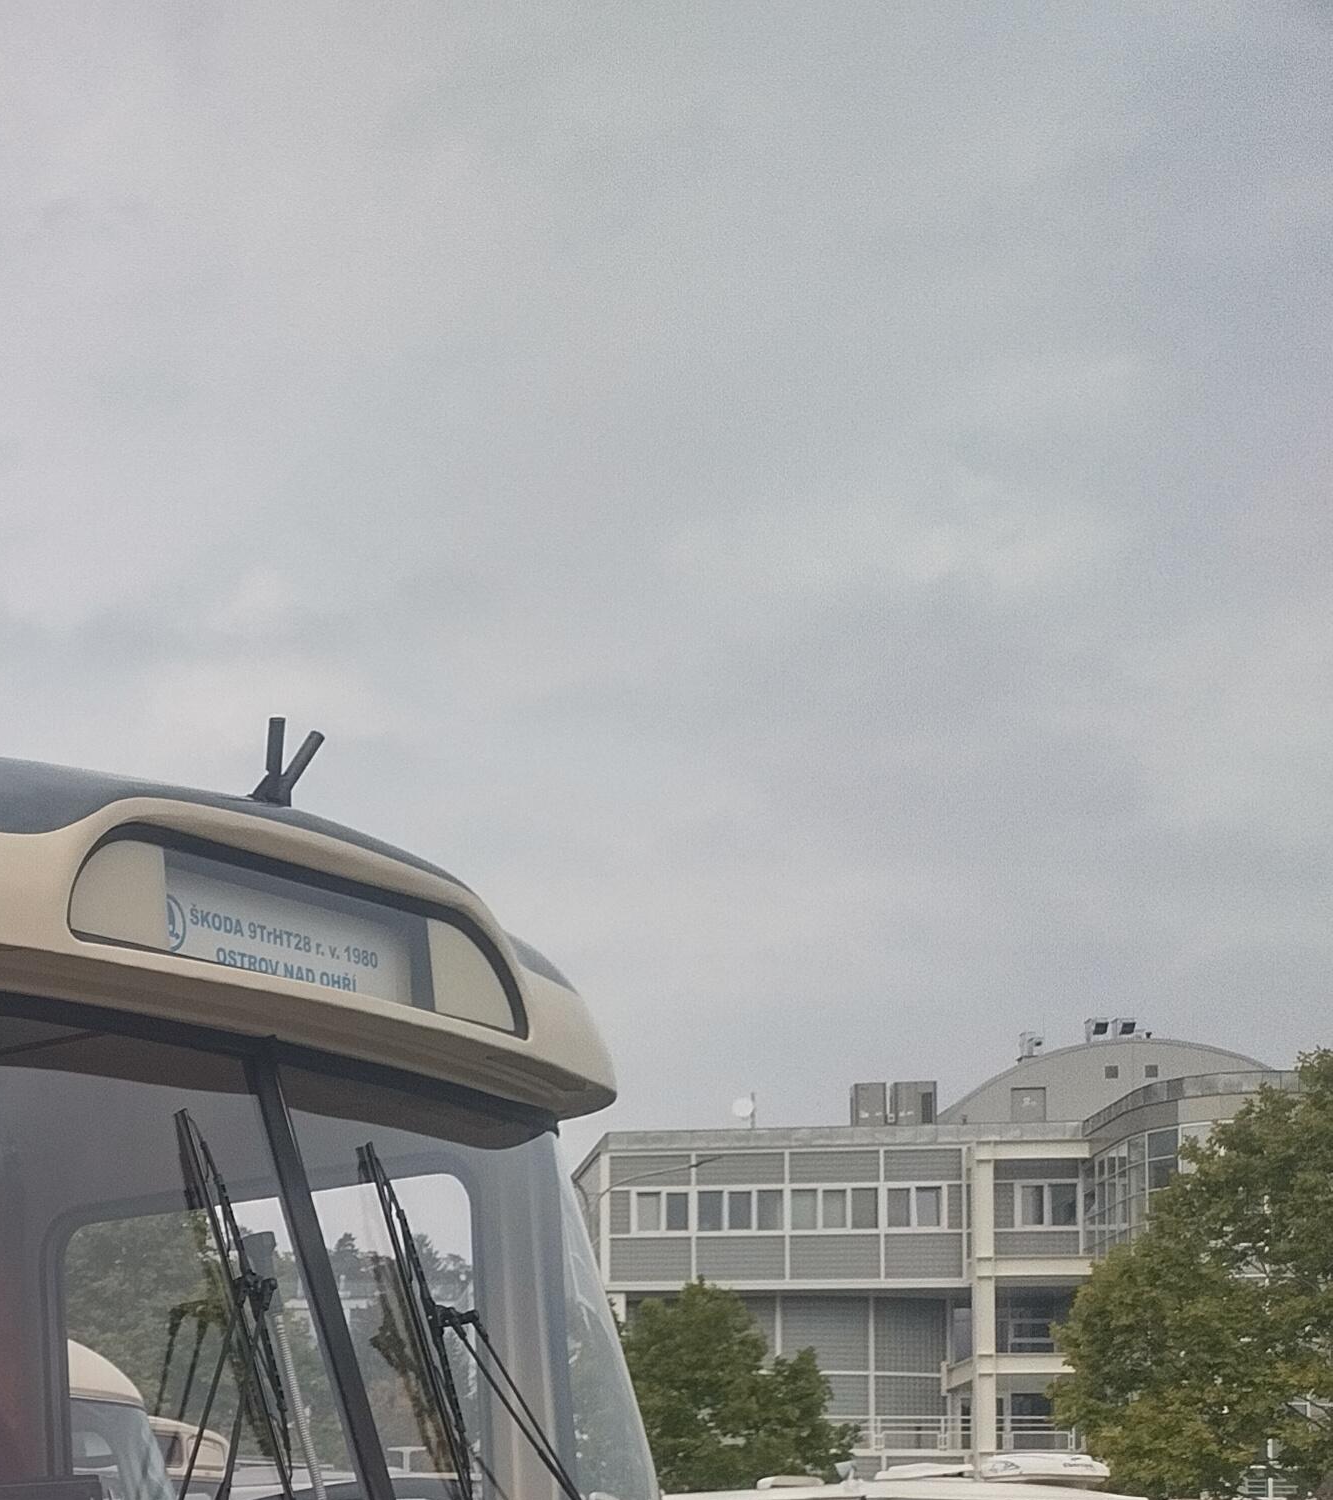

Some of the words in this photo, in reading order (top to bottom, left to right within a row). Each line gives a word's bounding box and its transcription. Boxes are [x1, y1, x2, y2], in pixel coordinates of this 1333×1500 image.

[189, 904, 244, 937] ŠKODA
[248, 922, 311, 953] 9TrHT28
[315, 942, 325, 956] r.
[328, 945, 340, 960] v.
[343, 945, 378, 968] 1980
[216, 947, 279, 975] OSTROV
[283, 964, 315, 983] NAD
[320, 972, 357, 992] OHŘÍ
